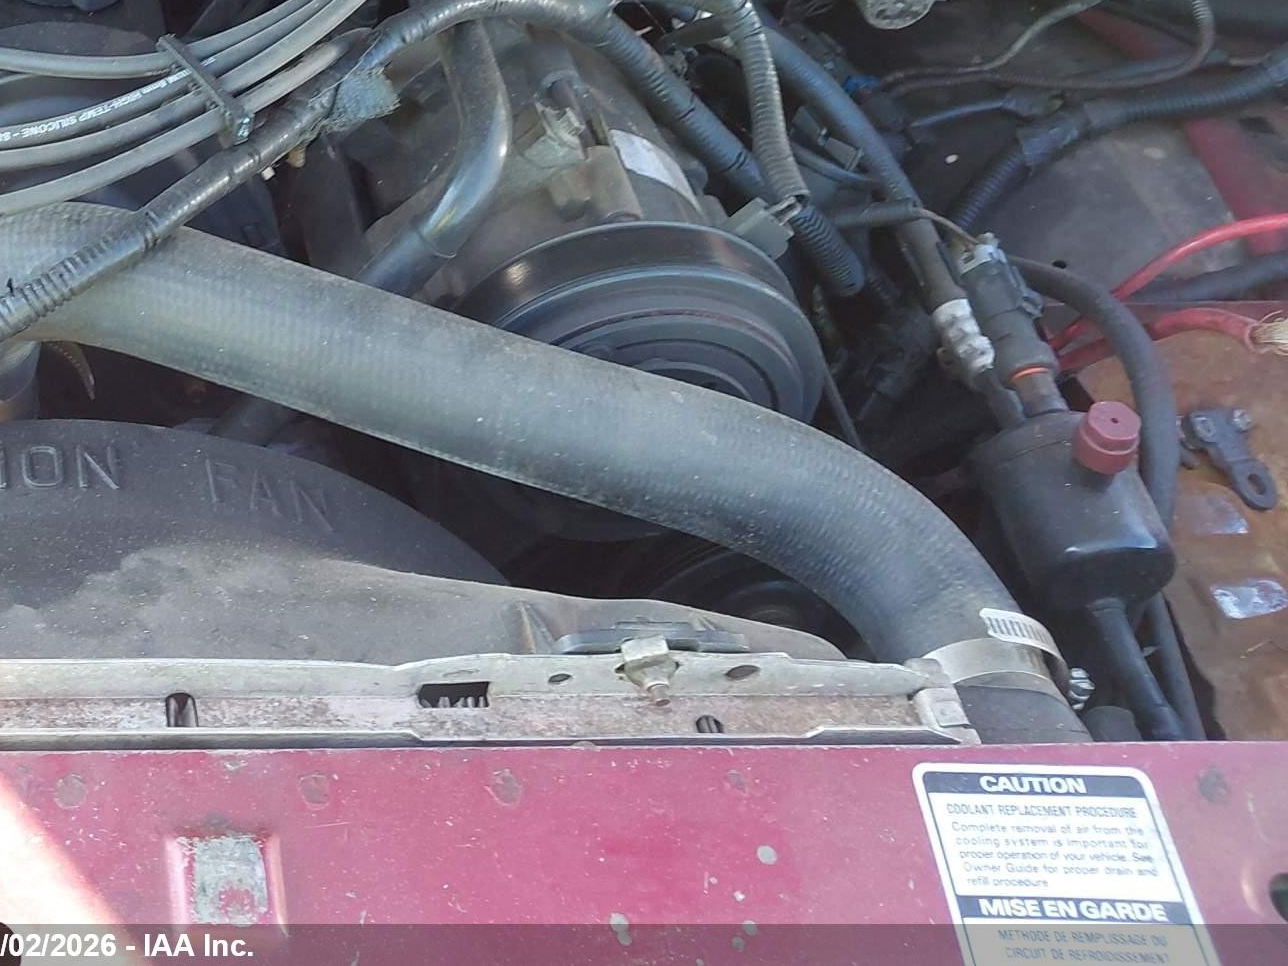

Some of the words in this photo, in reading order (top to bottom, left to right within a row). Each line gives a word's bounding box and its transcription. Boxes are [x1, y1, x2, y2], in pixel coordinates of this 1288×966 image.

[20, 115, 78, 139] SILICONE
[202, 456, 336, 533] FAN
[979, 775, 1087, 794] CAUTION
[946, 803, 993, 815] COOLANT
[997, 804, 1070, 817] REPLACEMENT
[1075, 806, 1137, 818] PROCEDURE
[951, 821, 1007, 833] Complete
[1011, 824, 1057, 833] removal
[1060, 825, 1071, 834] of
[1092, 824, 1121, 834] from
[1125, 825, 1144, 836] the
[956, 836, 1000, 848] cooling
[1004, 837, 1049, 848] system
[1067, 838, 1127, 849] important
[960, 851, 993, 860] proper
[997, 851, 1048, 860] operation
[1050, 850, 1059, 860] of
[963, 861, 1000, 872] Owner
[1006, 862, 1038, 873] Guide
[1042, 863, 1058, 873] for
[1063, 866, 1098, 876] proper
[978, 898, 1042, 917] MISE
[1043, 900, 1079, 919] EN
[1079, 900, 1170, 922] GARDE
[1053, 930, 1067, 943] DE
[1071, 931, 1148, 946] REMPLISSAGE
[1005, 947, 1047, 960] CIRCUIT
[1051, 948, 1064, 961] DE
